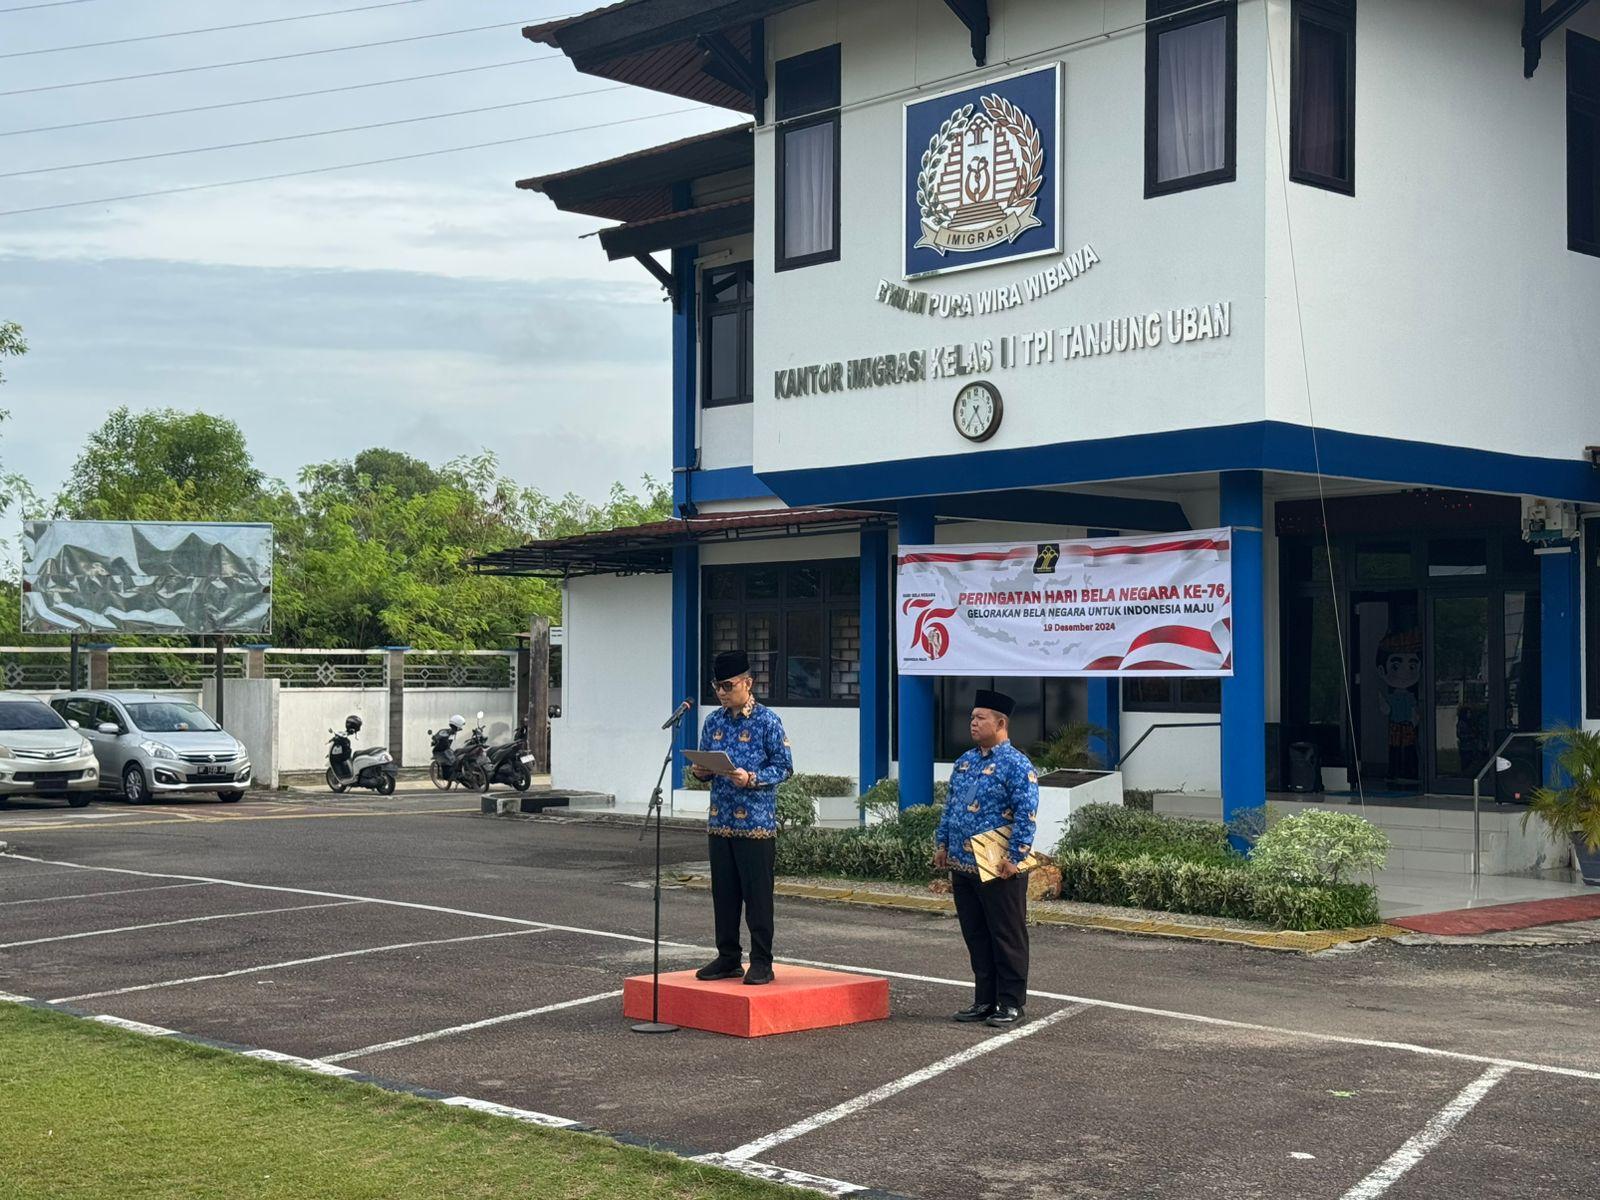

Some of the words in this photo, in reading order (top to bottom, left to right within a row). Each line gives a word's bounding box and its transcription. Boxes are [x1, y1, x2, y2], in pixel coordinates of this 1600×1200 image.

[947, 224, 1009, 245] IMIGRASI
[928, 293, 974, 318] PURA
[976, 283, 1023, 314] WIRA
[1024, 244, 1100, 300] WIBAWA
[774, 362, 843, 399] KANTOR
[847, 350, 926, 389] IMIGRASI
[931, 339, 993, 379] KELAS
[1000, 335, 1016, 368] II
[1021, 329, 1054, 365] TPI
[1059, 312, 1162, 359] TANJUNG
[1167, 301, 1231, 344] UBAN
[958, 590, 1041, 605] PERINGATAN
[1044, 589, 1077, 603] HARI
[1081, 588, 1115, 603] BELA
[1119, 585, 1180, 601] NEGARA
[1184, 583, 1225, 598] KE-76
[967, 608, 1021, 618] GELORAKAN
[1023, 607, 1046, 618] BELA
[1048, 606, 1086, 617] NEGARA
[1088, 605, 1122, 616] UNTUK
[1123, 604, 1181, 615] INDONESIA
[1184, 603, 1215, 613] MAJU
[1043, 624, 1052, 632] 19
[1054, 622, 1093, 632] Desember
[1095, 622, 1116, 631] 2024
